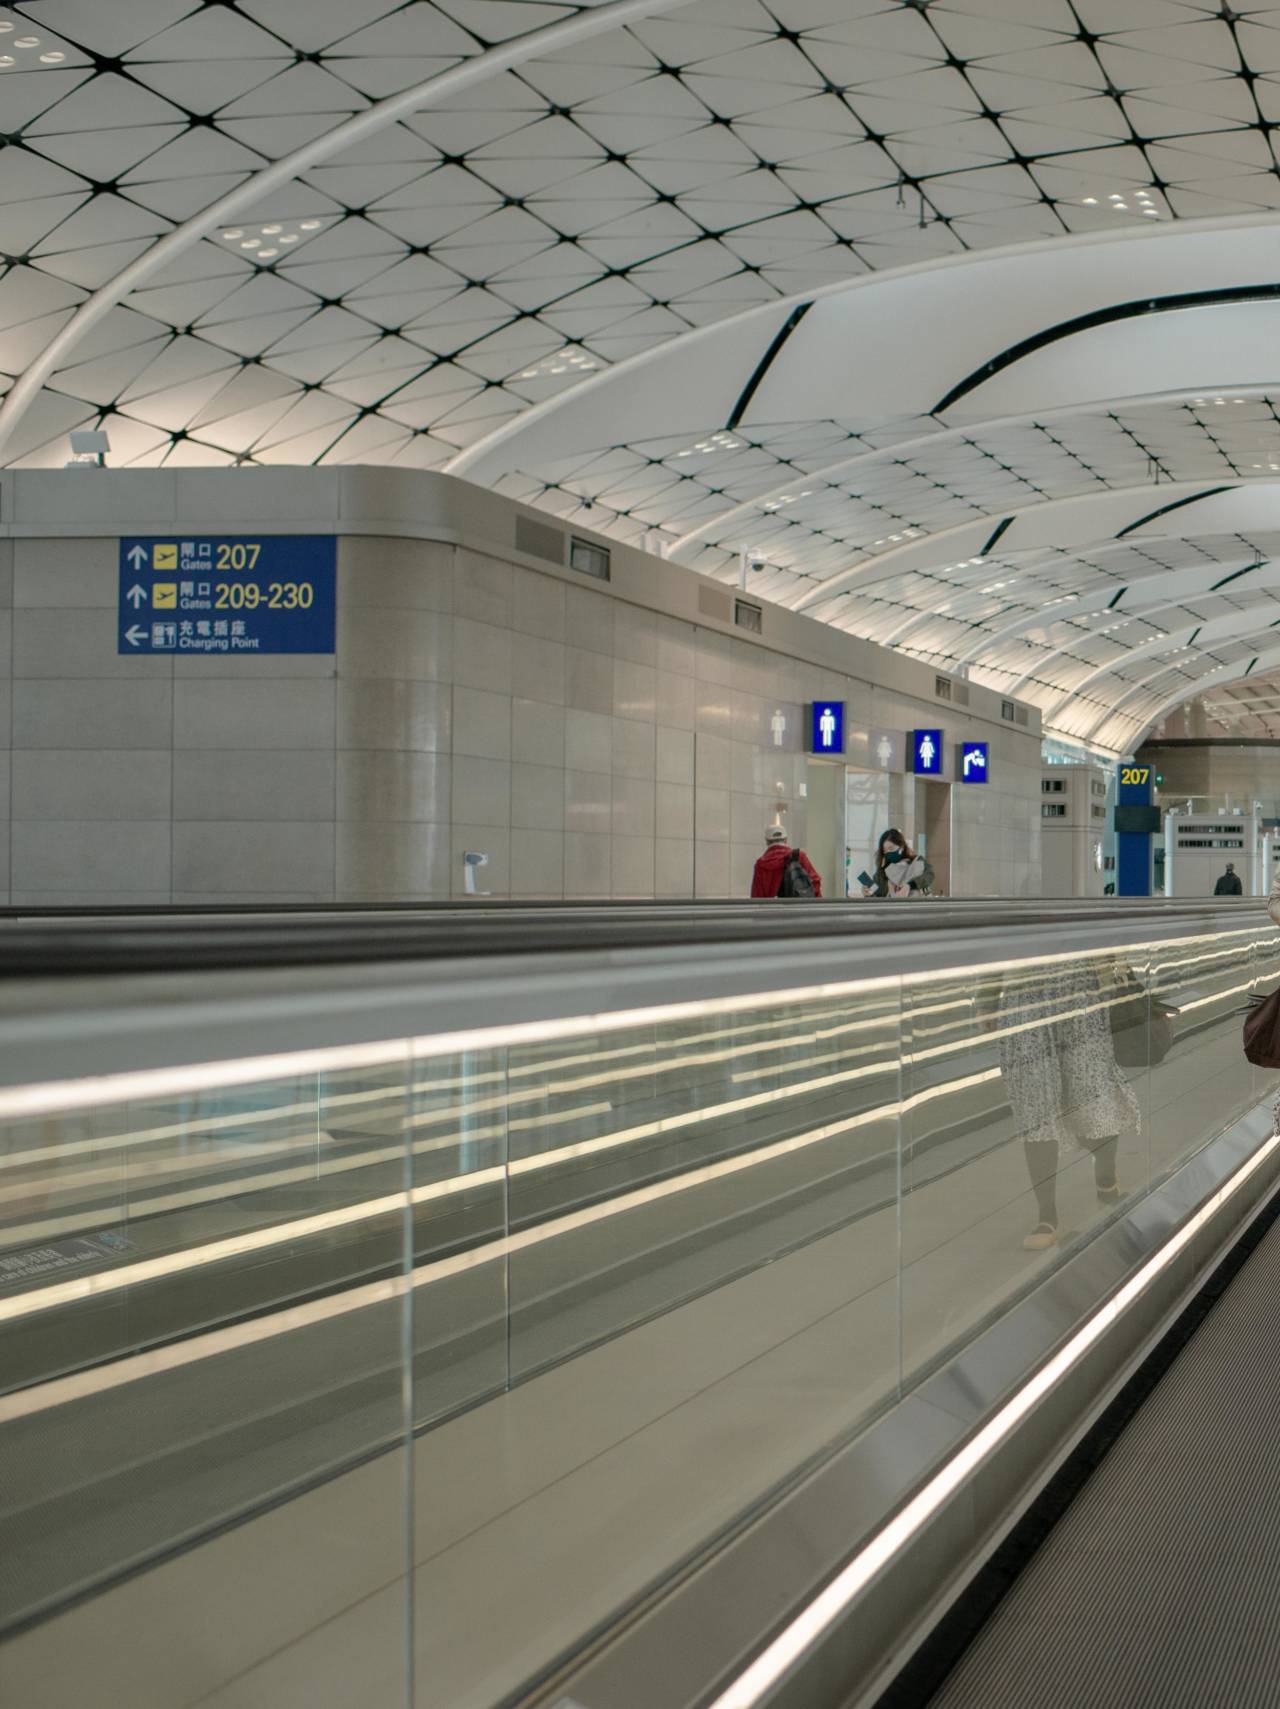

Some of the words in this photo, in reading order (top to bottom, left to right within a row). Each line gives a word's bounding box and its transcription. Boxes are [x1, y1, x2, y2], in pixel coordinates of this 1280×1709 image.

[180, 542, 211, 558] 閘口
[180, 558, 212, 570] Gates
[216, 544, 261, 570] 207
[180, 581, 211, 597] 閘口
[180, 599, 211, 609] Gates
[214, 583, 314, 609] 209-230
[179, 620, 246, 636] 充電插座
[179, 637, 229, 650] Charging
[231, 637, 259, 648] Point
[1121, 768, 1149, 785] 207
